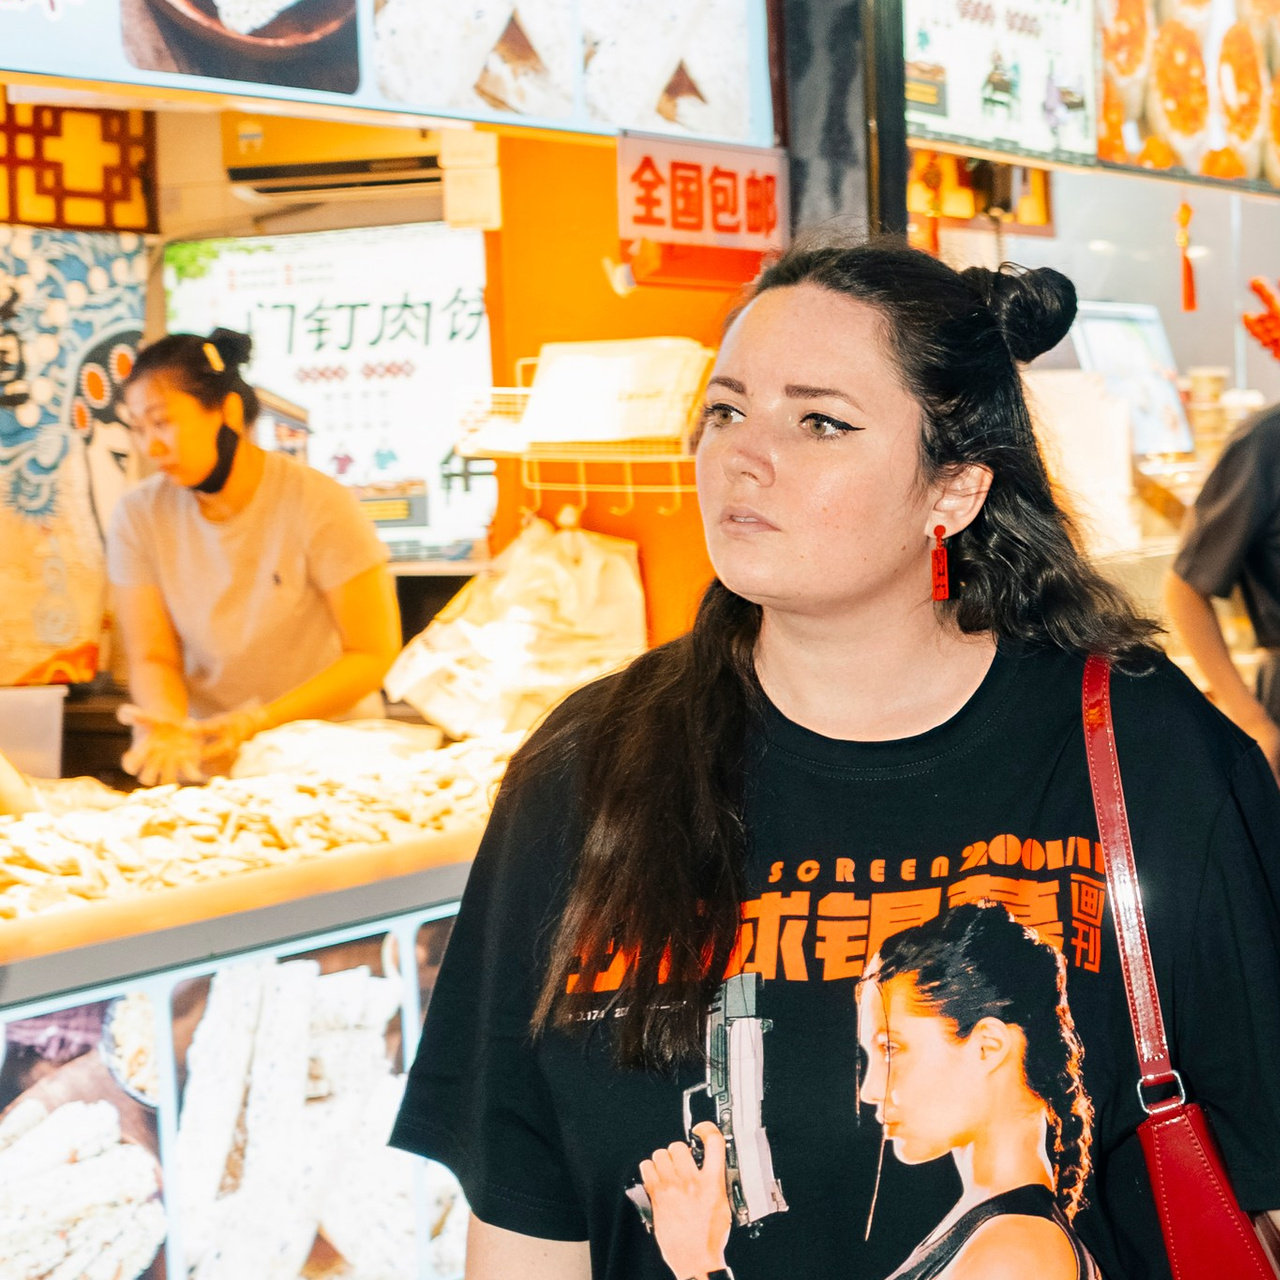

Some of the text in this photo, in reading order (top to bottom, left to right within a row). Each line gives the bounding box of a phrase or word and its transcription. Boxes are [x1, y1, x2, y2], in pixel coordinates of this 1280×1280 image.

[630, 153, 778, 239] 全国包邮
[1069, 872, 1106, 974] 画刊
